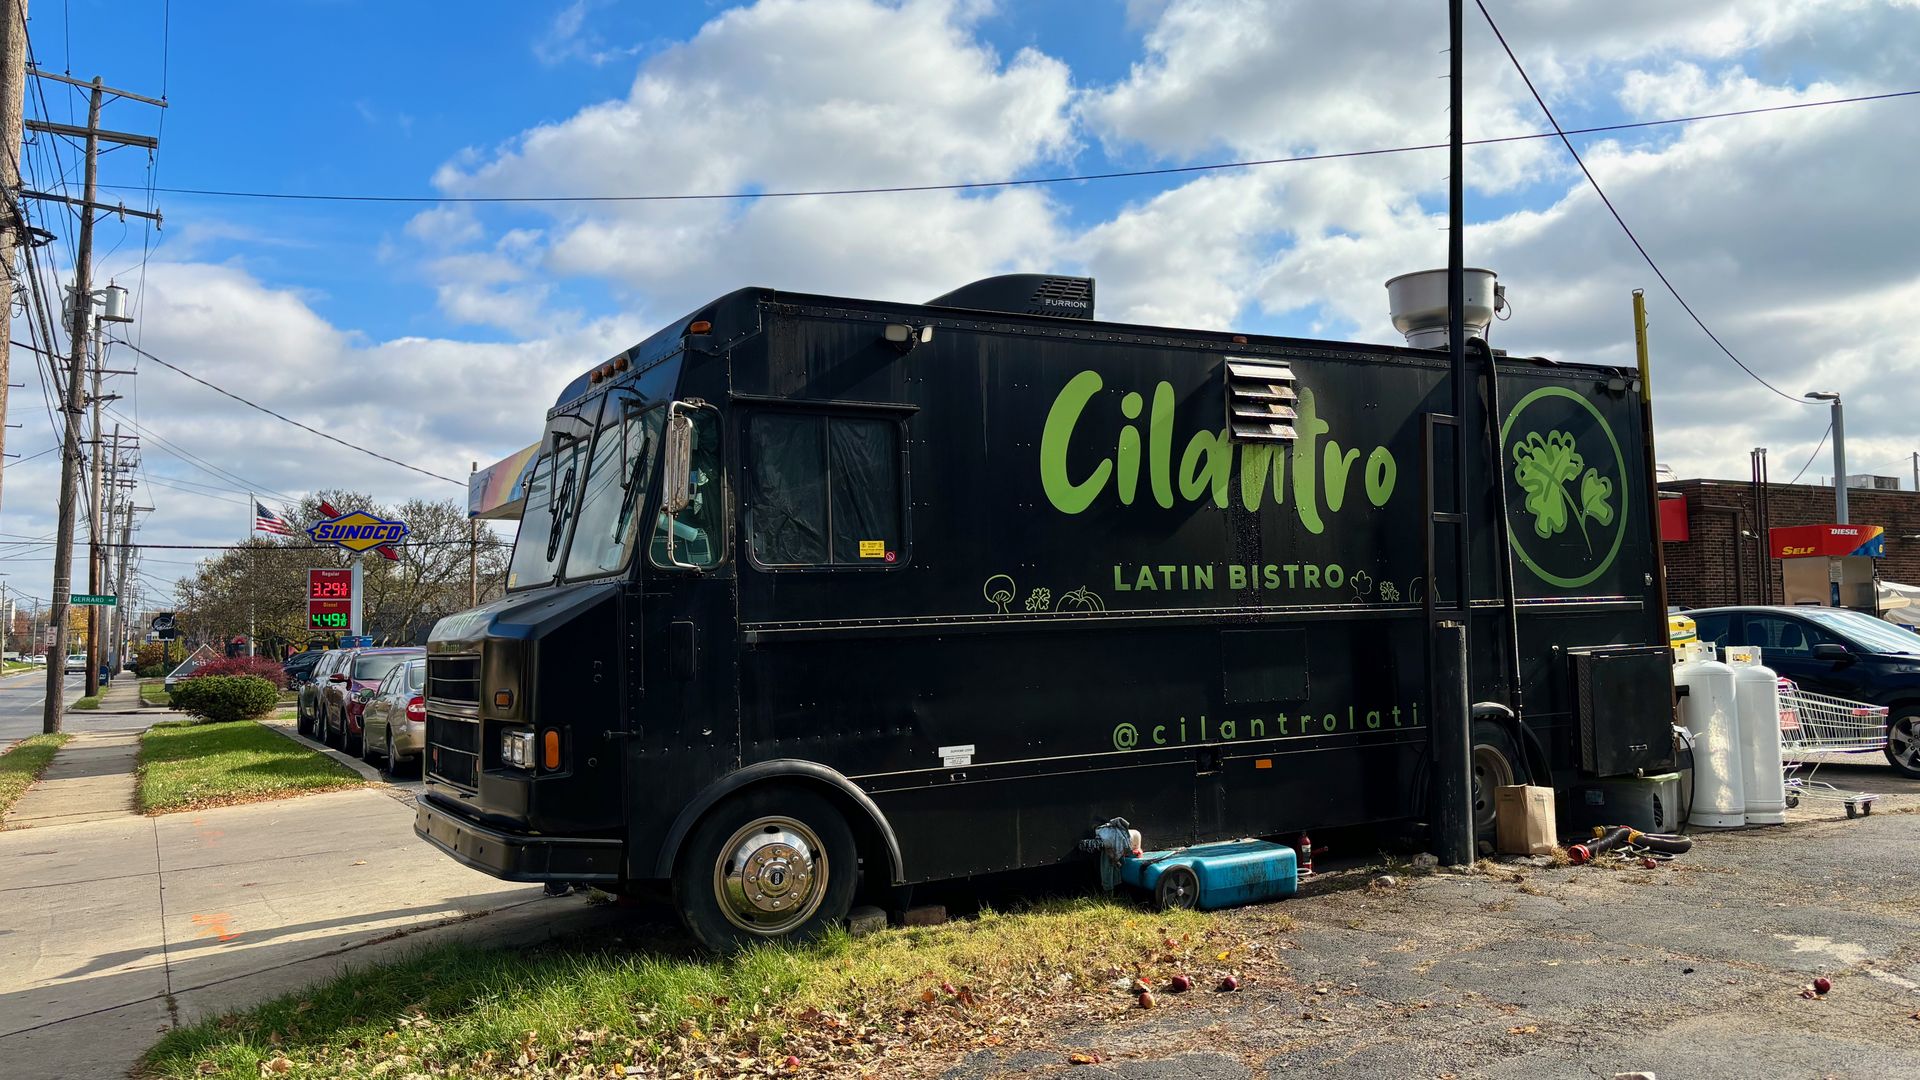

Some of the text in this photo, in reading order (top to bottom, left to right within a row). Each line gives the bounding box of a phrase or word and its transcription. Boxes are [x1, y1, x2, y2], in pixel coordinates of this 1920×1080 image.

[1045, 299, 1087, 308] FURRION
[1040, 370, 1397, 534] Cilantro
[317, 524, 402, 540] SUNOCO
[1114, 564, 1344, 591] LATIN BISTRO
